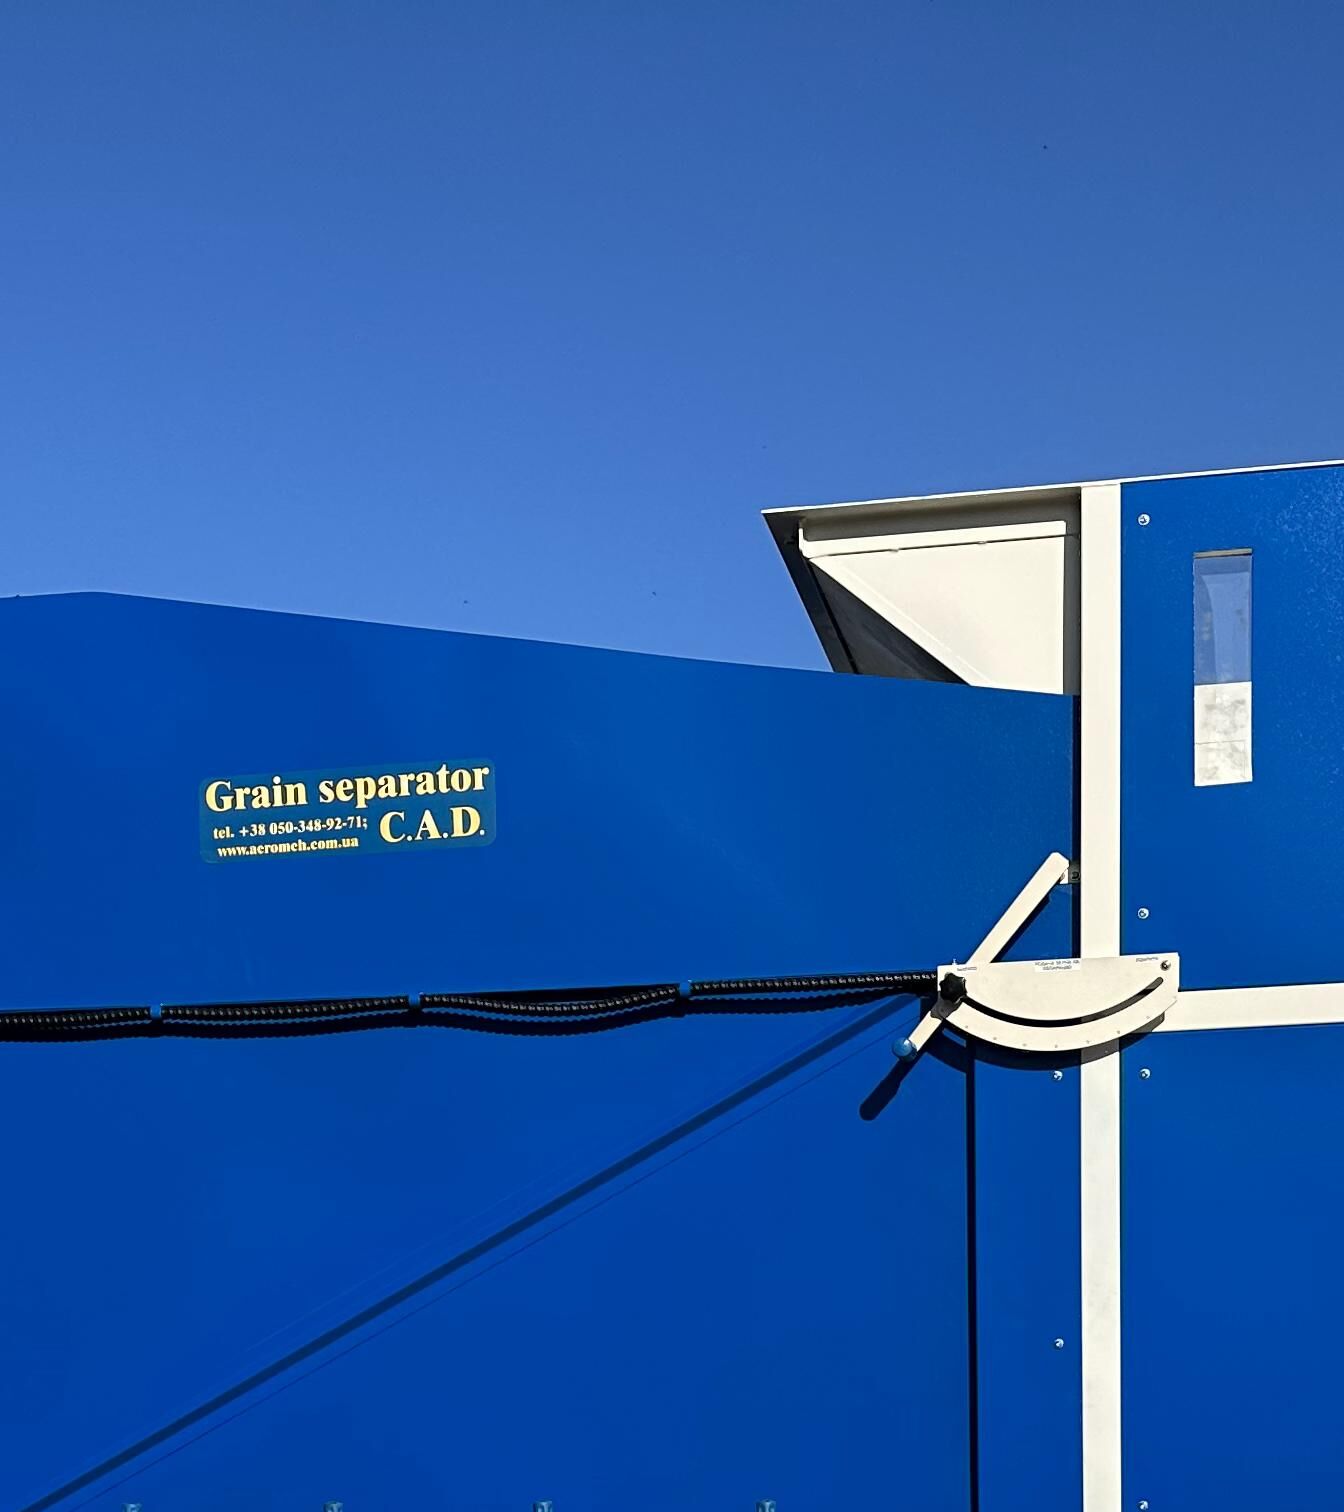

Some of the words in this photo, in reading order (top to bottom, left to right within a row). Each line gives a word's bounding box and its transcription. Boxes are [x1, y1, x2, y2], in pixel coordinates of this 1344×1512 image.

[205, 775, 308, 813] Grain
[319, 763, 490, 808] separator
[213, 826, 235, 840] tel.
[239, 823, 265, 838] +38
[269, 815, 368, 837] 050-348-92-71;
[379, 806, 486, 844] C.A.D.
[217, 837, 359, 858] www.aeromeh.com.ua
